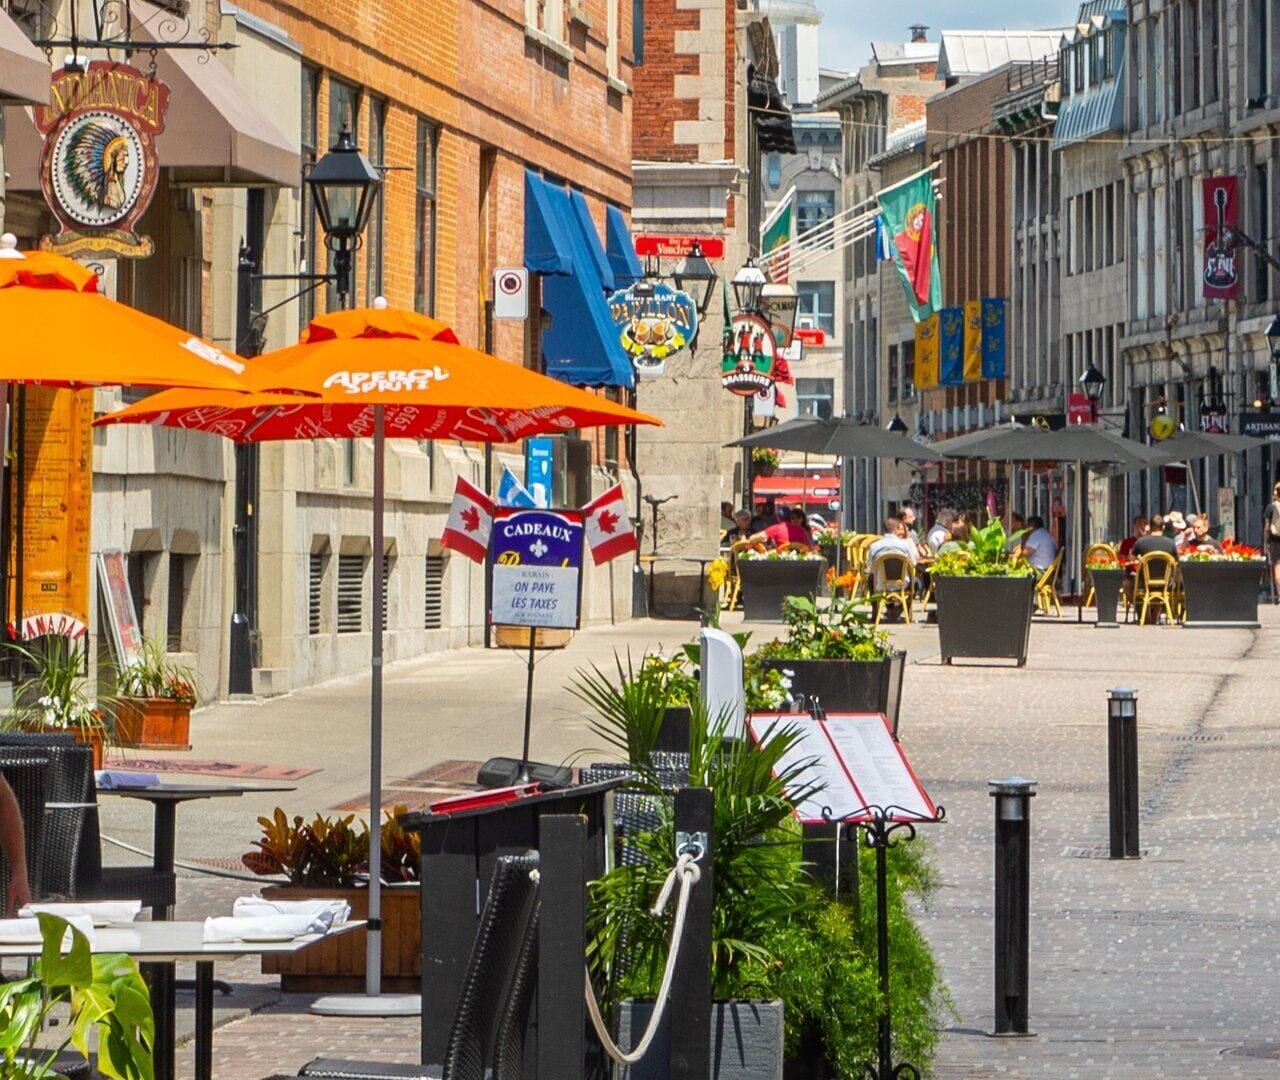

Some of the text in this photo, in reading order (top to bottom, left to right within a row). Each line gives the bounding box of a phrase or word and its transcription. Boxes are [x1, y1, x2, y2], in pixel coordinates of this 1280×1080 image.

[657, 244, 703, 255] Vaudrel
[323, 366, 449, 389] APEROL
[722, 373, 772, 387] BRASSEURS
[345, 379, 429, 394] SPRITZ
[503, 523, 572, 542] CADEAUX
[514, 581, 556, 593] ON PAYE
[511, 597, 558, 610] LES TAXES
[22, 616, 76, 641] ANADA
